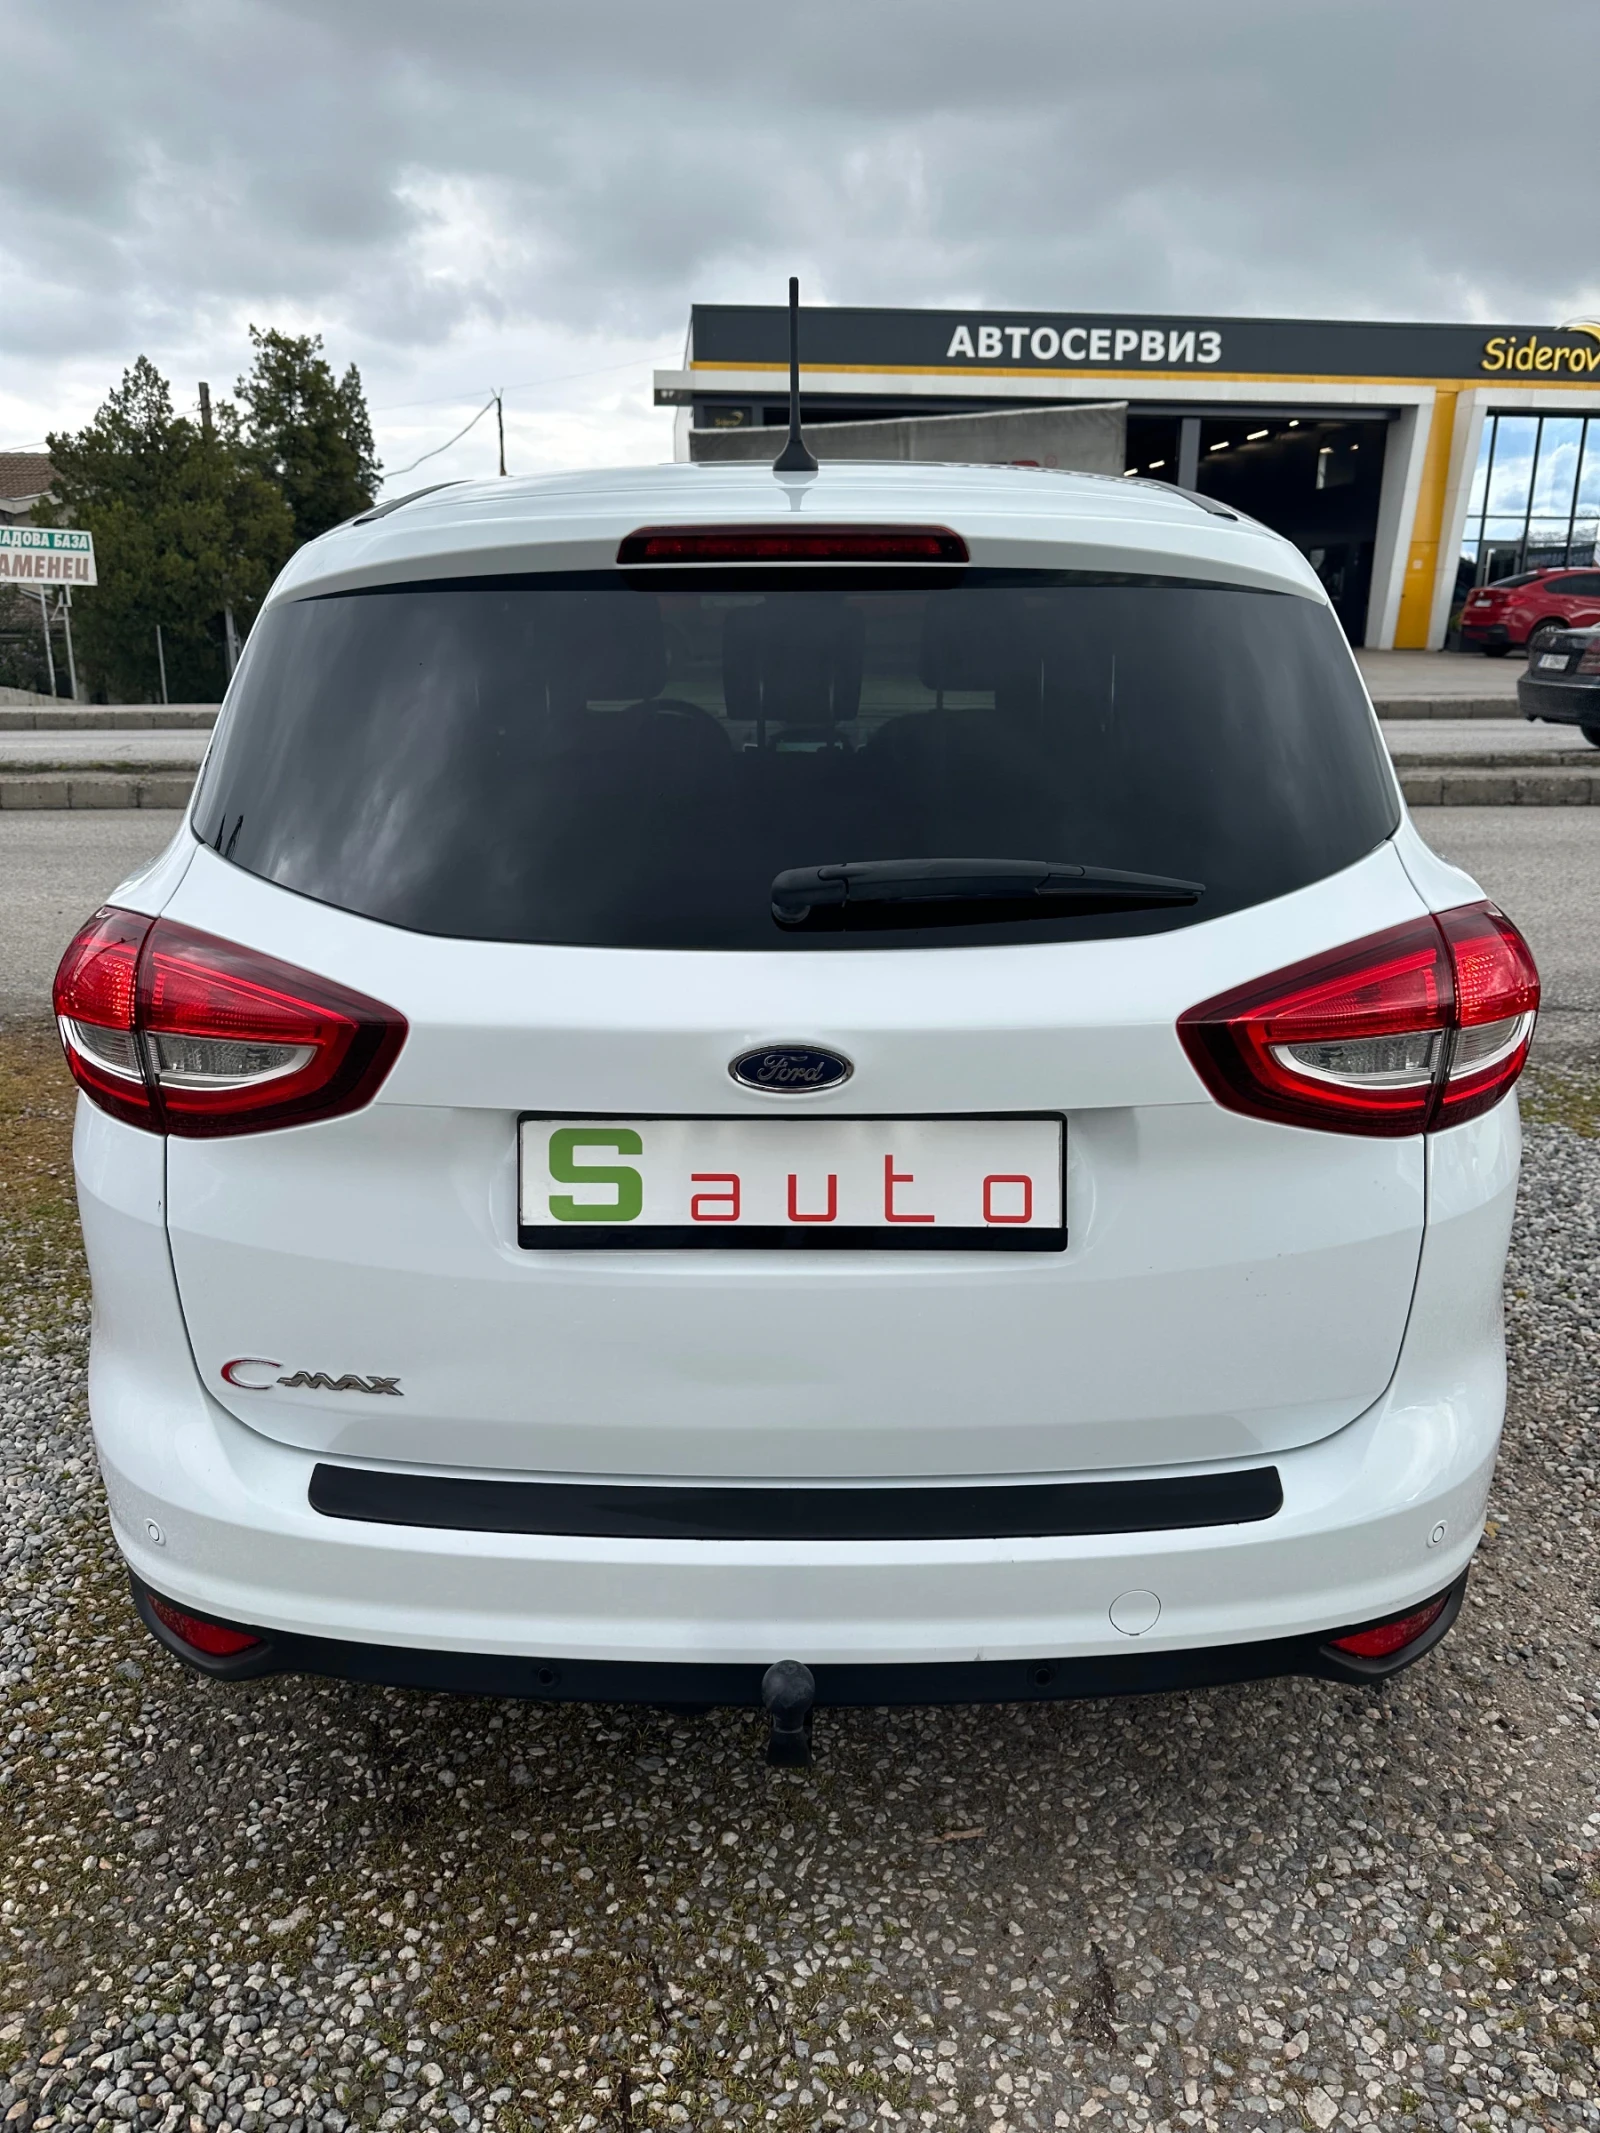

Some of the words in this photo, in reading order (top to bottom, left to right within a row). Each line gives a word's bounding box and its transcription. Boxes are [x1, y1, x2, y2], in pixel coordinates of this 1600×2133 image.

[946, 325, 1223, 364] АВТОСЕРВИЗ
[1481, 335, 1600, 372] Siderov
[0, 530, 50, 548] АДОВА
[53, 534, 88, 549] БАЗА
[756, 1054, 825, 1082] Ford
[548, 1128, 643, 1222] S
[690, 1154, 1033, 1223] auto
